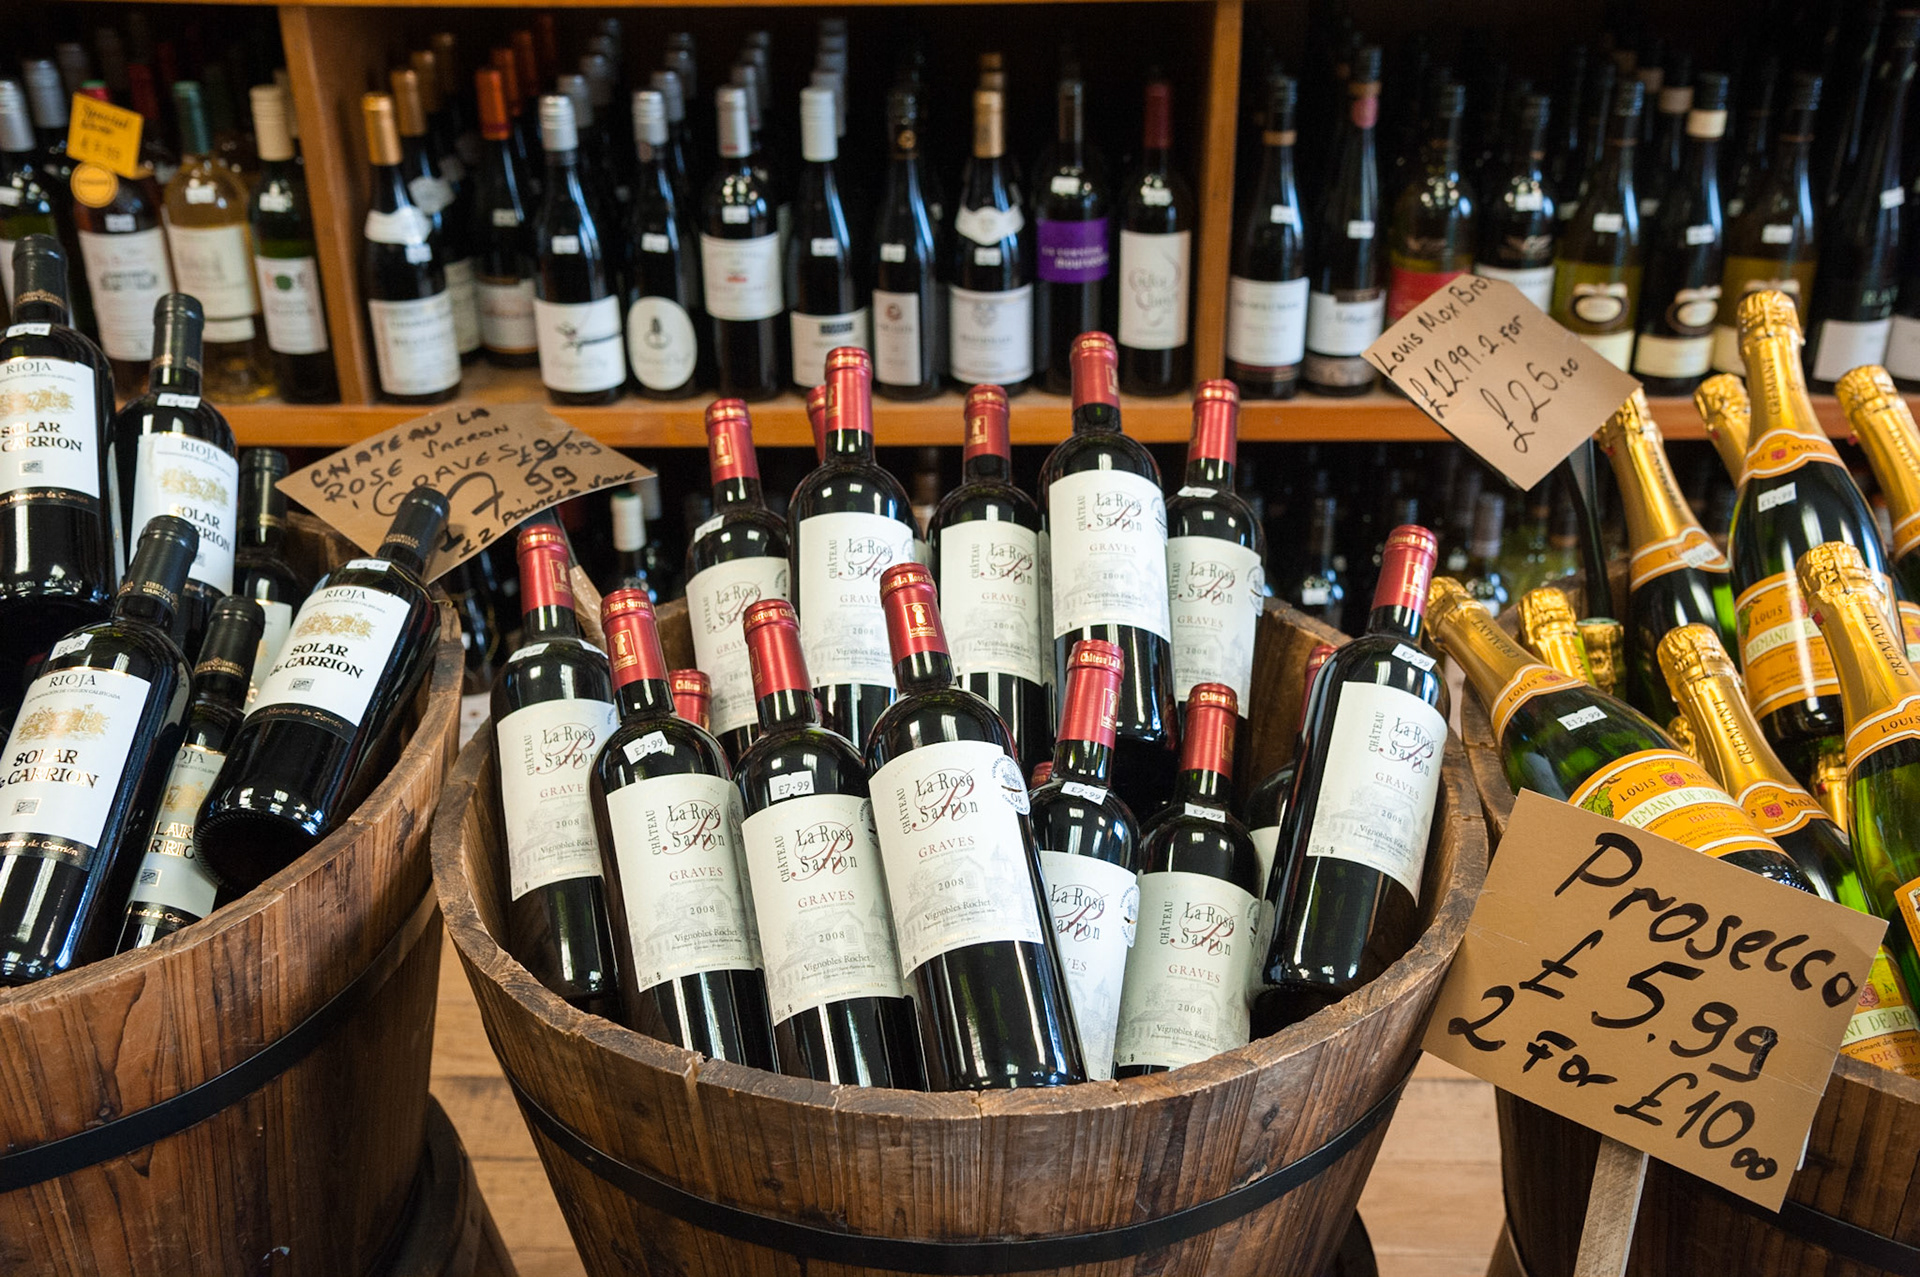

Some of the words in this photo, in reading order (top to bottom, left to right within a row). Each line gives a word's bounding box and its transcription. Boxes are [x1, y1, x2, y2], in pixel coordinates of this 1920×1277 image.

[1373, 335, 1423, 377] Louis
[6, 362, 52, 374] RIOJA
[457, 407, 491, 425] LA
[1, 421, 60, 439] SOLAR
[180, 441, 219, 461] RIOJA
[1791, 443, 1820, 451] MAX
[324, 459, 403, 504] ROSE
[1096, 492, 1112, 508] La
[1114, 493, 1142, 512] Rose
[175, 506, 221, 530] SOLAR
[1096, 512, 1142, 532] Sarron
[848, 538, 865, 555] La
[867, 539, 892, 558] Rose
[990, 543, 1006, 558] La
[1009, 545, 1033, 565] Rose
[1088, 541, 1138, 555] GRAVES
[828, 539, 838, 580] CHÂTEAU
[989, 563, 1033, 586] Sarron
[1190, 560, 1206, 578] La
[1209, 562, 1236, 583] Rose
[325, 589, 366, 600] RIOJA
[716, 589, 732, 606] La
[733, 585, 761, 600] Rose
[981, 592, 1028, 607] GRAVES
[1187, 583, 1233, 606] Sarron
[1177, 614, 1224, 630] GRAVES
[1754, 605, 1783, 626] LOUIS
[1471, 619, 1519, 659] CREMANT
[1864, 612, 1909, 677] CREMANT
[290, 643, 349, 657] SOLAR
[285, 656, 364, 679] CARRION
[48, 674, 97, 688] RIOJA
[1508, 679, 1538, 702] LOUIS
[543, 729, 561, 744] La
[564, 725, 595, 743] Rose
[1368, 711, 1385, 753] CHÂTEAU
[1394, 717, 1411, 737] La
[1413, 724, 1436, 752] Rose
[1714, 699, 1754, 765] CREMANT
[13, 748, 78, 766] SOLAR
[524, 734, 535, 776] CHÂTEAU
[1389, 739, 1430, 778] Sarron
[8, 767, 99, 788] CARRION
[915, 778, 934, 797] La
[938, 772, 974, 790] Rose
[1374, 771, 1420, 800] GRAVES
[540, 783, 584, 799] GRAVE
[1619, 778, 1656, 802] LOUIS
[668, 805, 687, 822] La
[690, 802, 721, 821] Rose
[897, 787, 911, 835] CHÂTEAU
[919, 800, 979, 823] Sarron
[1623, 796, 1677, 828] REMANT
[1680, 792, 1698, 801] DE
[1785, 799, 1814, 808] MAX
[556, 817, 580, 829] 2008
[1380, 808, 1403, 825] 2008
[1688, 811, 1727, 824] BRUT
[645, 809, 662, 856] CHÂTEAU
[672, 831, 725, 849] Sarron
[795, 828, 815, 847] La
[818, 825, 853, 843] Rose
[1359, 823, 1392, 845] Vignobles
[918, 835, 975, 858] GRAVES
[774, 835, 790, 883] CHÂTEAU
[800, 854, 858, 874] Sarron
[669, 867, 724, 881] GRAVES
[938, 877, 965, 891] 2008
[797, 890, 855, 909] GRAVES
[1051, 884, 1068, 905] La
[1073, 887, 1105, 911] Rose
[690, 905, 715, 916] 2008
[924, 901, 962, 922] Vignobles
[962, 899, 991, 910] Rochet
[1185, 902, 1201, 920] La
[1206, 905, 1235, 930] Rose
[1554, 832, 1858, 1008] Prosecco
[1057, 917, 1100, 940] arron
[1160, 900, 1173, 945] CHÂTEAU
[674, 929, 713, 943] Vignobles
[819, 931, 845, 943] 2008
[1181, 927, 1232, 956] Sarron
[803, 956, 842, 972] Vignobles
[843, 953, 871, 964] Rochet
[1168, 964, 1221, 984] GRAVES
[1177, 1003, 1203, 1015] 2008
[1447, 985, 1515, 1052] 2
[1156, 1023, 1193, 1039] Vignobles
[1867, 1011, 1892, 1032] DE
[1850, 1042, 1881, 1055] Crémant
[1870, 1045, 1918, 1064] BRUT
